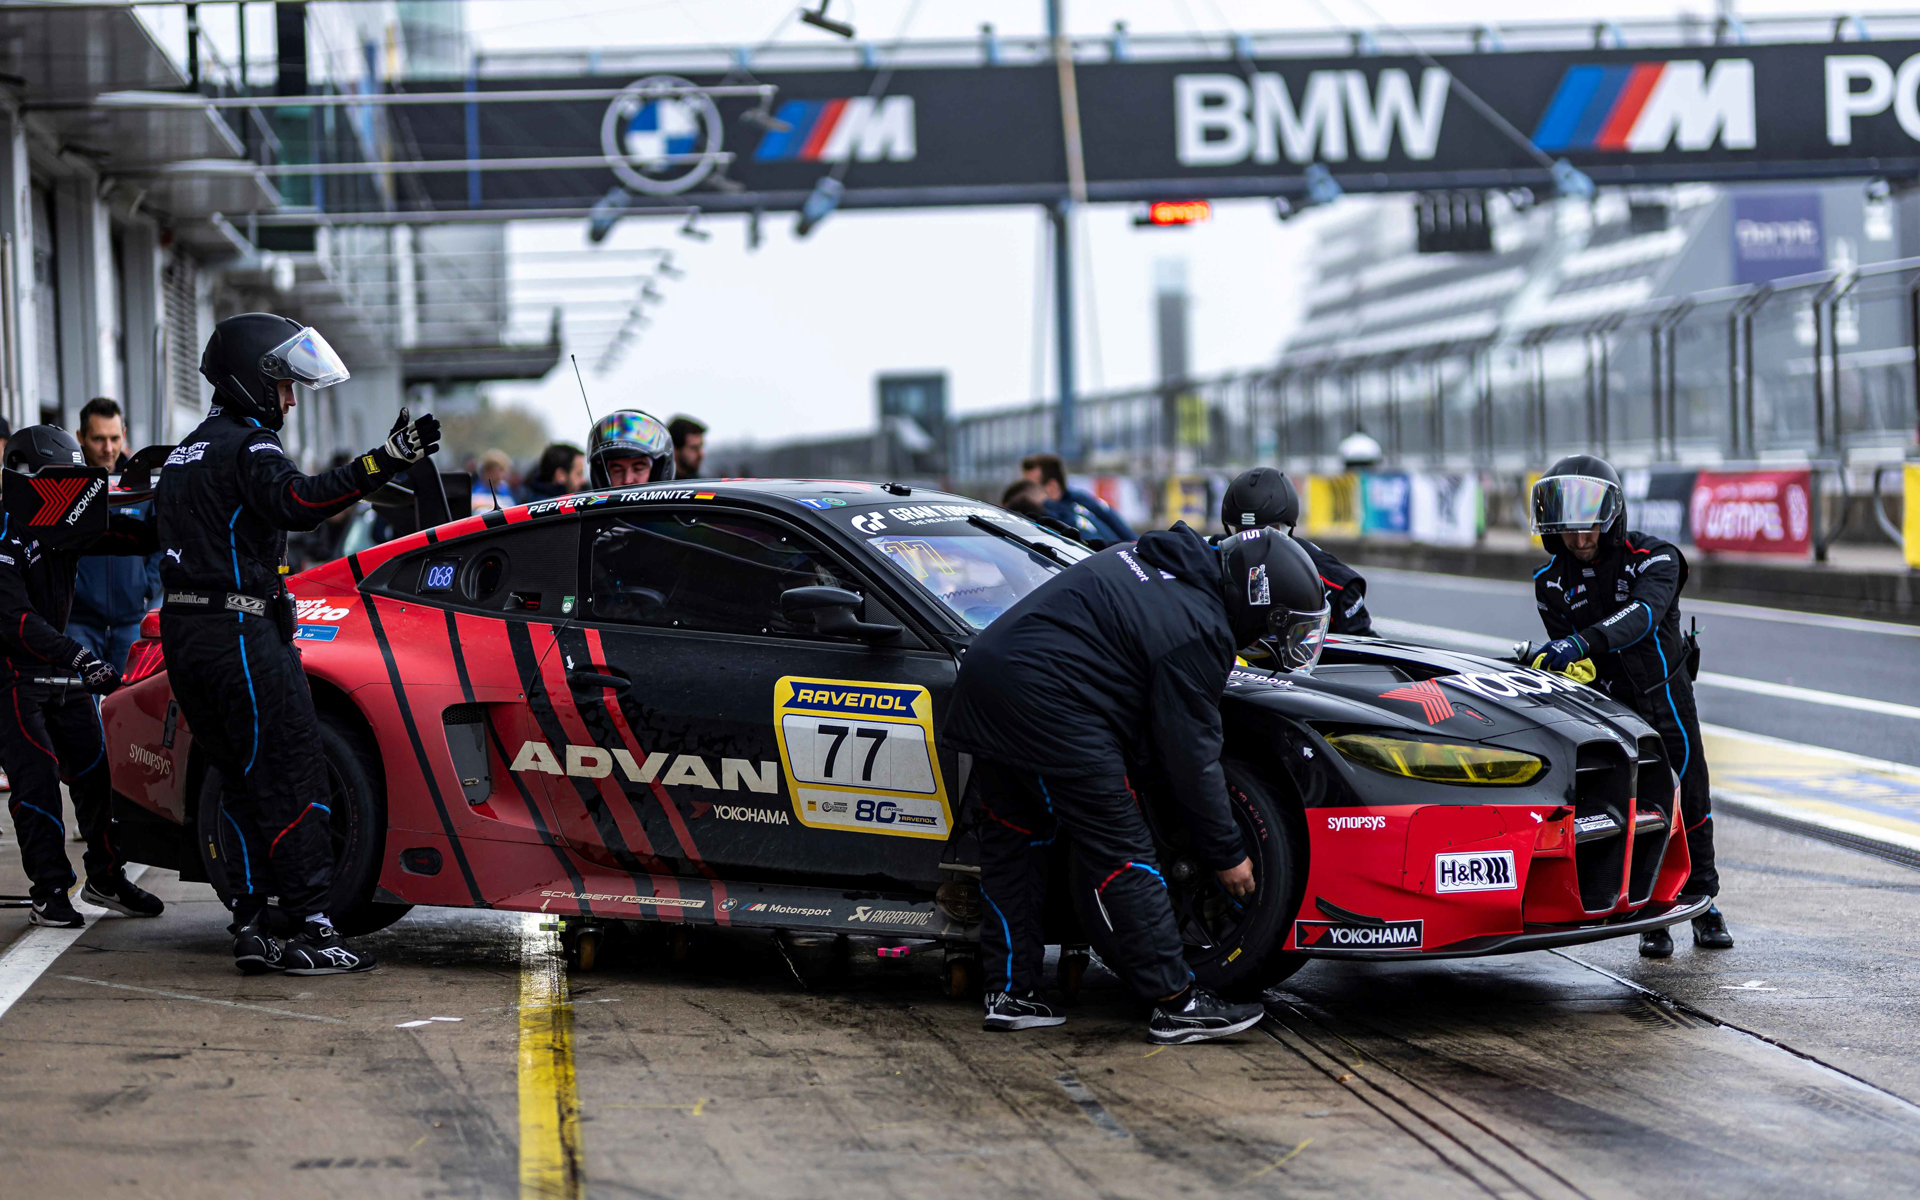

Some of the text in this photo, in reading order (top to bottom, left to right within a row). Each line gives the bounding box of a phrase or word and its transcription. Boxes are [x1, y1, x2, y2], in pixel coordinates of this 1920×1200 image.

[1174, 66, 1451, 167] BMW
[1624, 57, 1756, 153] M
[527, 490, 694, 515] PEPPER TRAMNITZ
[888, 505, 937, 522] GRAN
[875, 539, 955, 578] 77
[1116, 550, 1149, 582] Motorsport
[427, 566, 454, 587] 068
[296, 598, 326, 609] port
[297, 606, 350, 621] uto
[797, 689, 907, 711] RAVENOL
[817, 724, 888, 782] 77
[509, 740, 778, 794] ADVAN
[713, 804, 790, 826] YOKOHAMA
[855, 799, 897, 824] 80
[901, 815, 934, 824] RAVENOL
[1440, 858, 1487, 887] H&R
[540, 890, 623, 902] SCHUBERT
[625, 896, 703, 907] MOTORSPORT
[768, 904, 832, 917] Motorsport
[1329, 926, 1418, 944] YOKOHAMA
